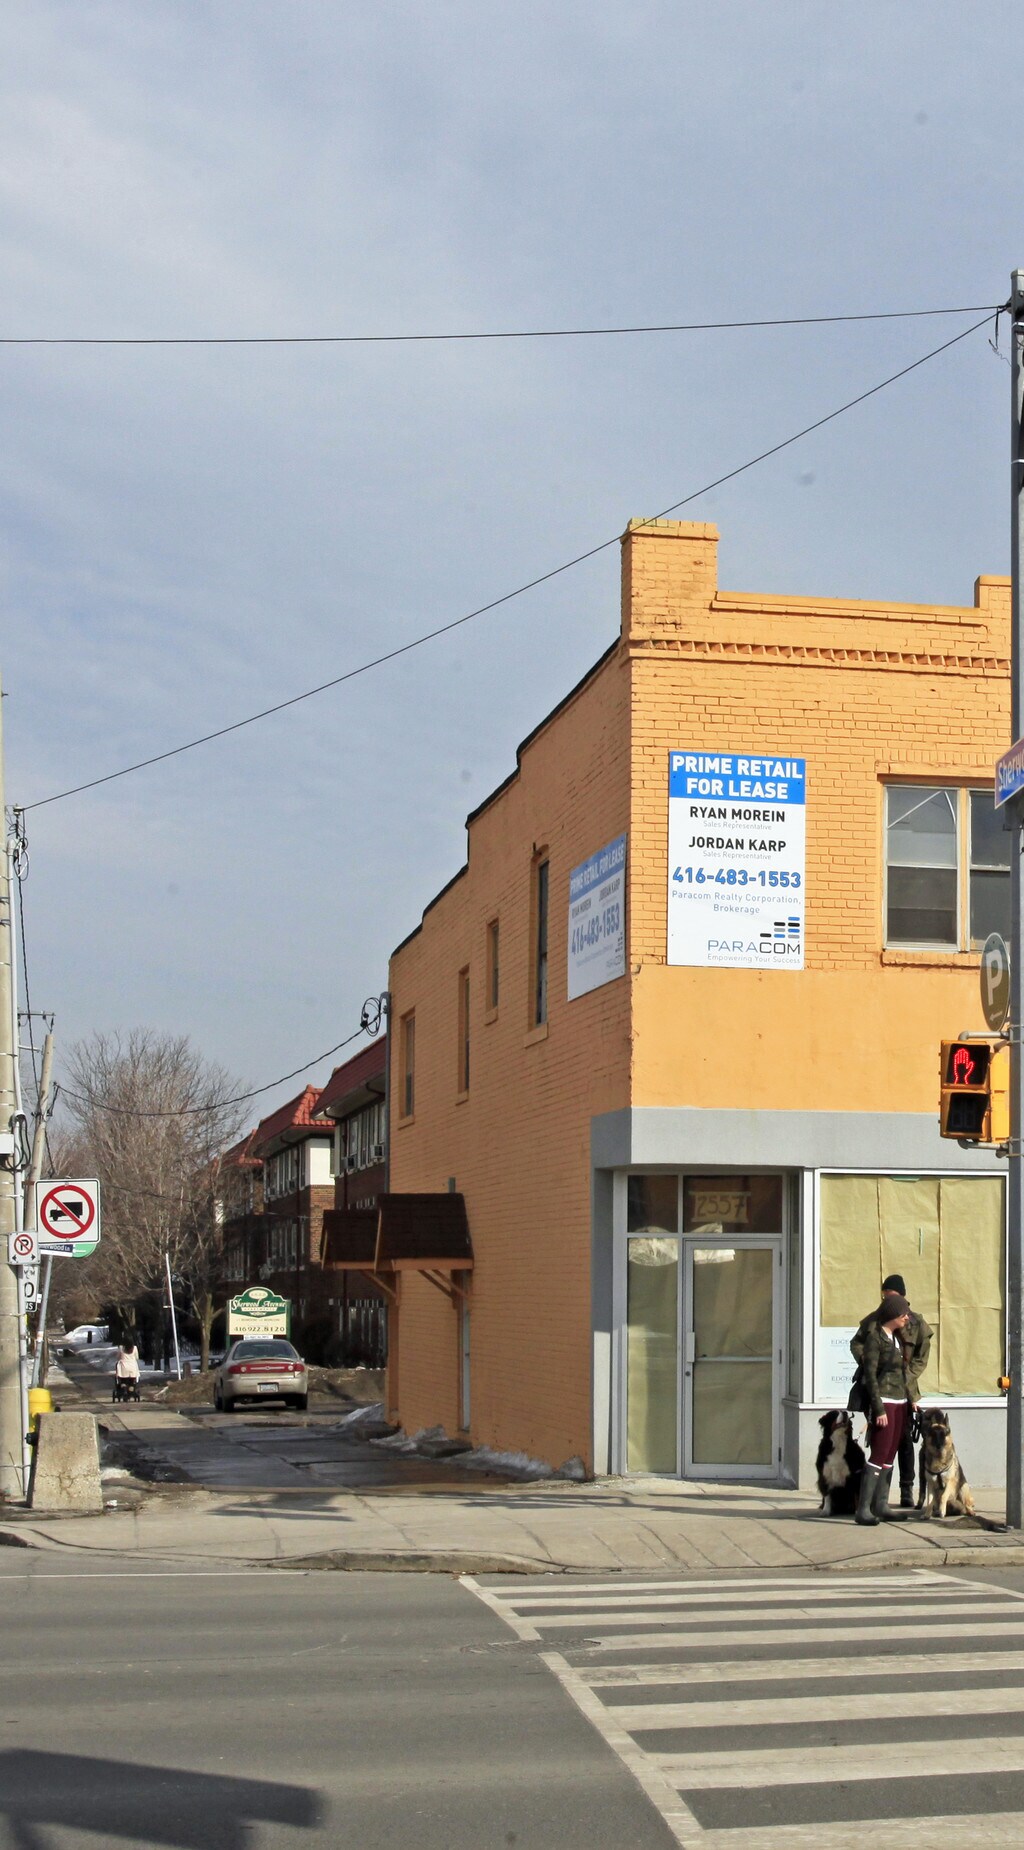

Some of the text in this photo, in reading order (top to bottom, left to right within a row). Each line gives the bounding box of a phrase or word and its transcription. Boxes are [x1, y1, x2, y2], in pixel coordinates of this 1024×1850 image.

[672, 755, 803, 779] PRIME RETAIL
[686, 778, 788, 799] FOR LEASE
[689, 806, 785, 822] RYAN MOREIN
[703, 820, 772, 831] Sales Representative
[688, 836, 786, 852] JORDAN KARP
[702, 850, 772, 860] Sales Representative
[672, 867, 801, 888] 416-483-1553
[672, 890, 801, 905] Paracom Realty Corporation,
[713, 904, 760, 915] Brokerage
[707, 939, 801, 955] PARACOM
[707, 954, 752, 963] Empowering
[754, 955, 771, 963] Your
[985, 949, 1003, 1006] P
